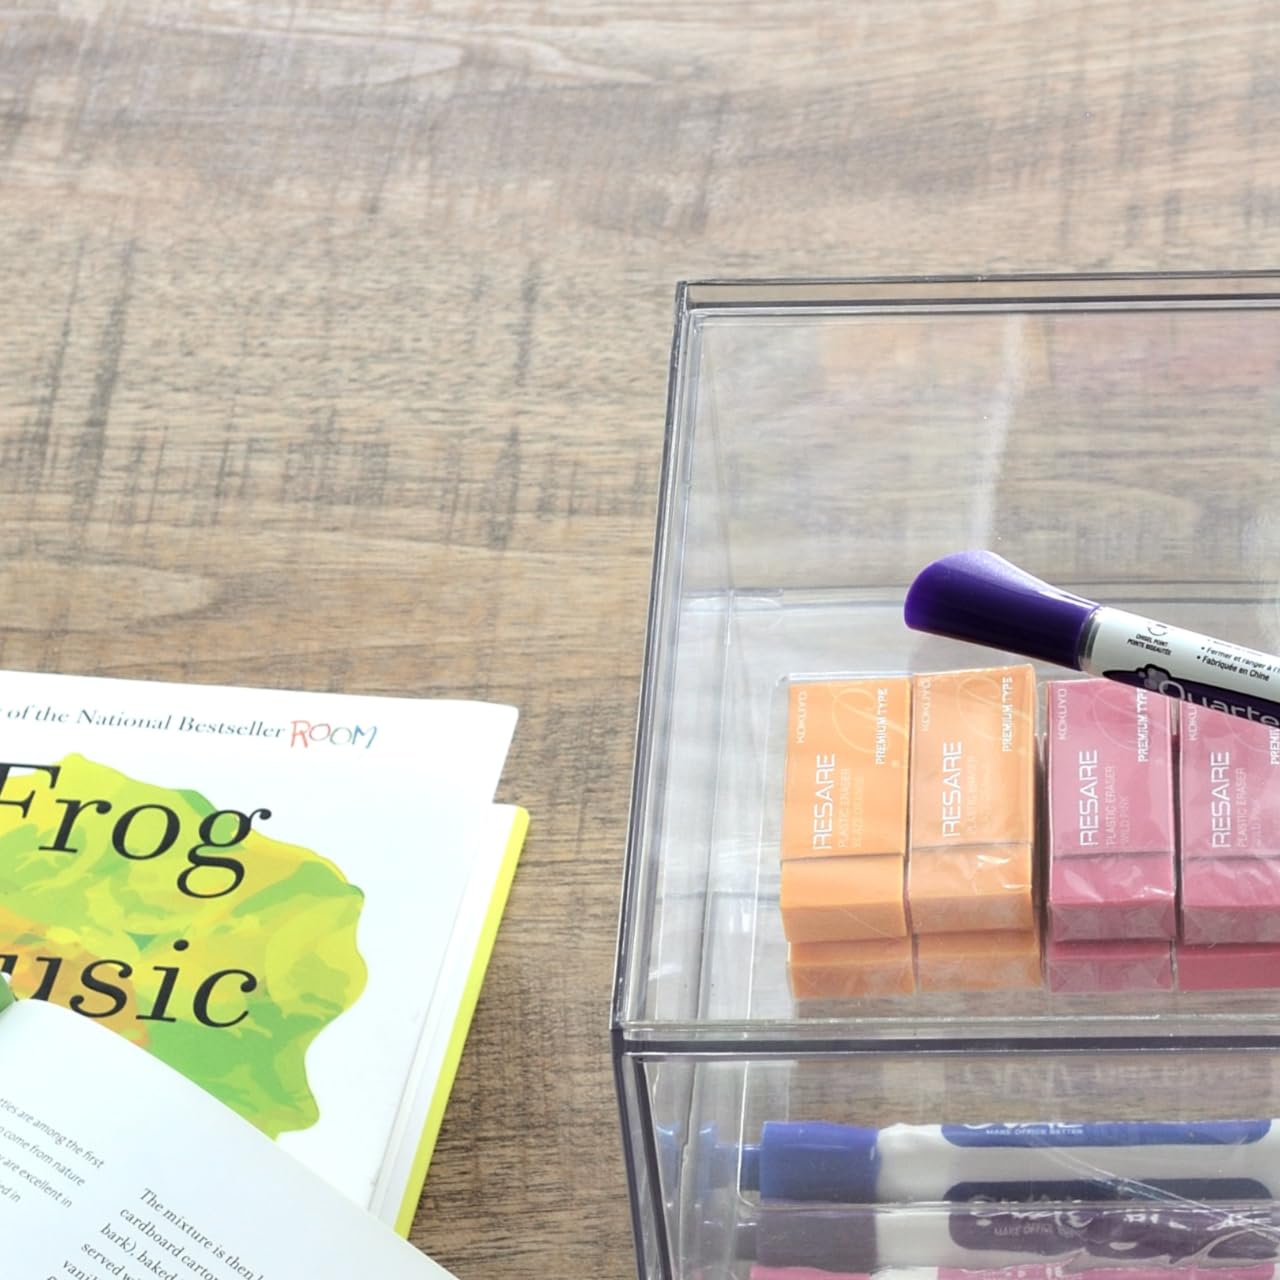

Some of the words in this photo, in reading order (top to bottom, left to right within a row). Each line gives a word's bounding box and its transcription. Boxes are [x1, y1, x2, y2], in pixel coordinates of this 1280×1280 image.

[1202, 655, 1238, 674] Fabriquée
[1239, 666, 1248, 676] en
[1249, 668, 1270, 682] Chine
[1233, 655, 1242, 663] et
[1242, 658, 1266, 670] ranger
[877, 688, 888, 715] TYPE
[1002, 676, 1013, 703] TYPE
[8, 705, 31, 721] of
[31, 706, 69, 723] the
[76, 709, 172, 731] National
[178, 717, 286, 739] Bestseller
[290, 720, 378, 749] ROOM
[1002, 704, 1013, 752] PREMIUM
[1058, 688, 1067, 740] KOKUYO
[875, 717, 888, 765] PREMIUM
[1136, 716, 1148, 763] PREMIUM
[812, 753, 835, 850] RESARE
[942, 741, 962, 837] RESARE
[1079, 750, 1099, 847] RESARE
[1210, 752, 1231, 849] RESARE
[0, 762, 272, 898] Frog
[120, 1209, 186, 1258] cardboard
[140, 1188, 164, 1212] The
[162, 1209, 213, 1249] mixture
[212, 1245, 226, 1259] is
[225, 1256, 254, 1280] then
[81, 1244, 125, 1276] served
